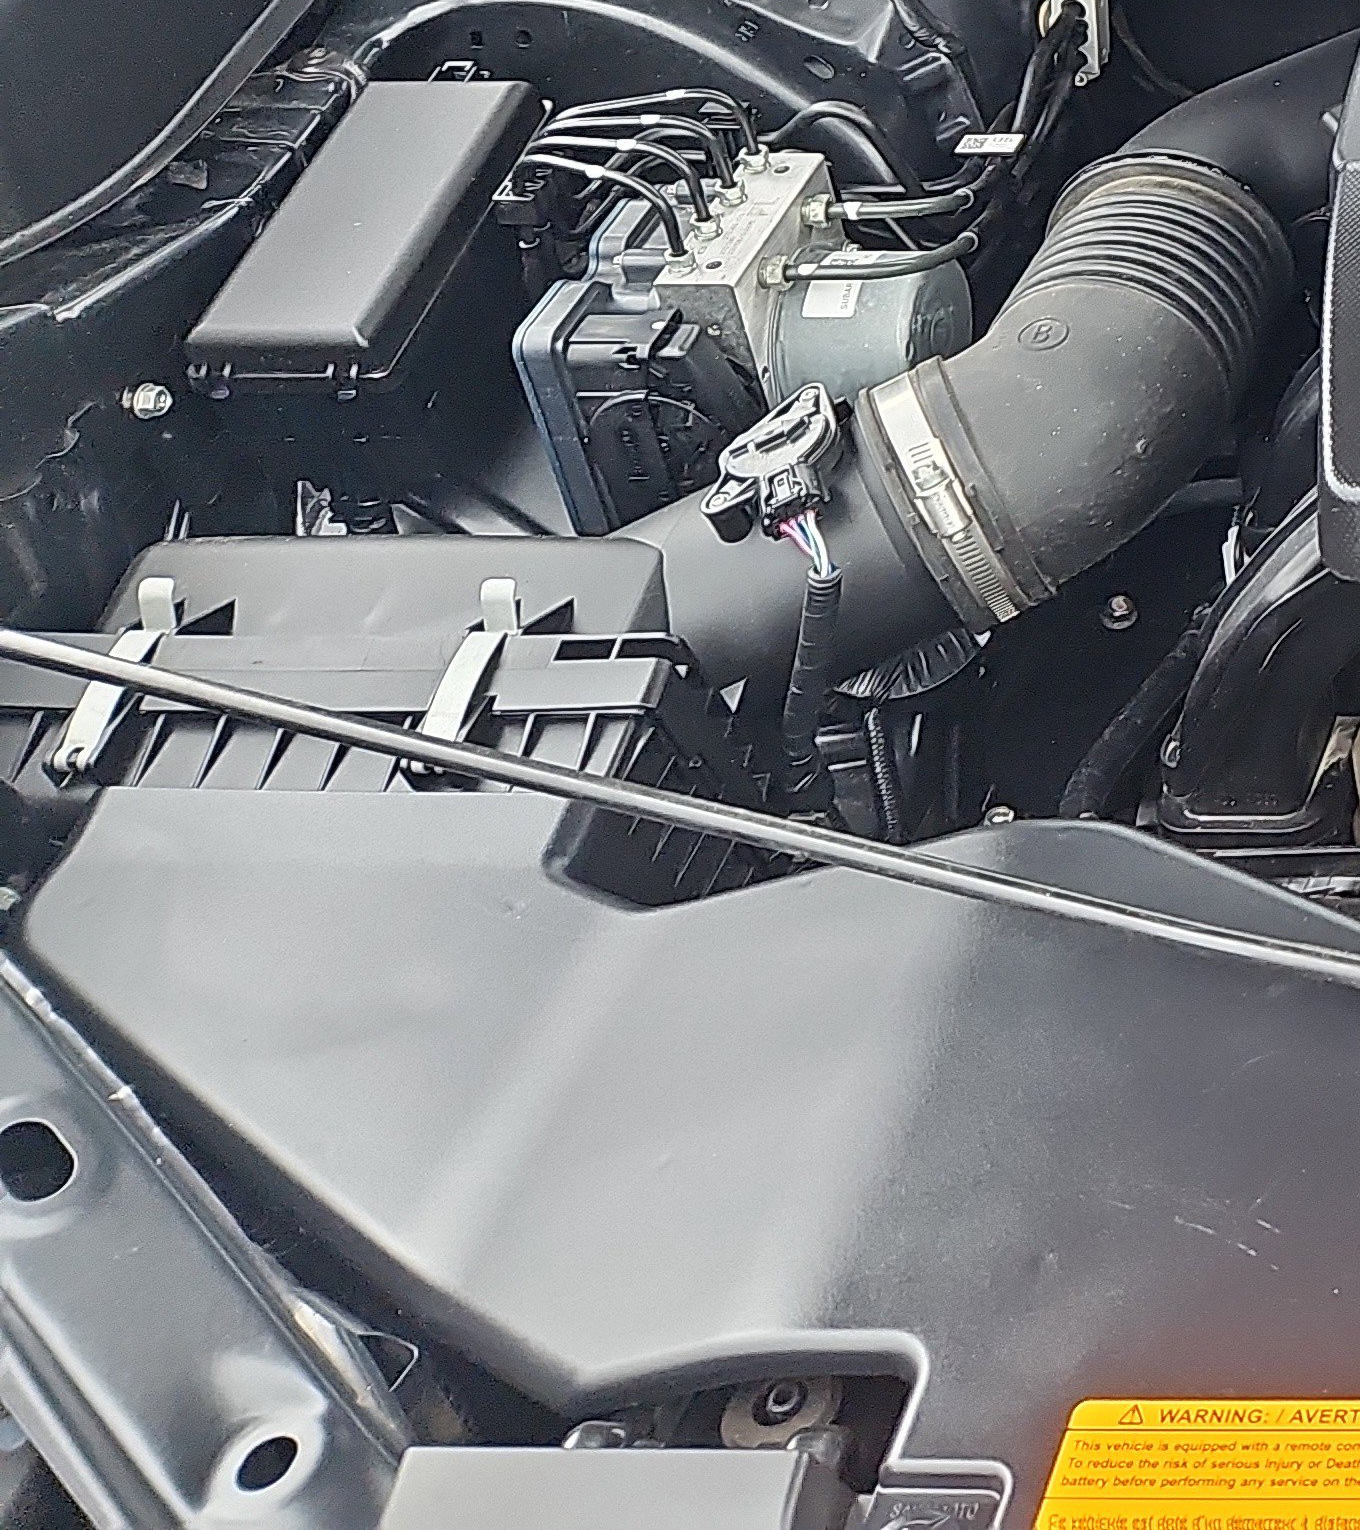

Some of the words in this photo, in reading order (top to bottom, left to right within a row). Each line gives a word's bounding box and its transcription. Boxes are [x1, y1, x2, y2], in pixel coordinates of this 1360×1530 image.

[1033, 324, 1052, 343] B
[1159, 1408, 1269, 1424] WARNING:
[1074, 1439, 1101, 1452] This
[1106, 1439, 1154, 1452] vehicle
[1157, 1440, 1169, 1452] is
[1173, 1440, 1237, 1455] equipped
[1240, 1439, 1269, 1452] with
[1272, 1443, 1281, 1452] a
[1284, 1441, 1332, 1452] remote
[1068, 1457, 1083, 1469] To
[1087, 1457, 1134, 1469] reduce
[1138, 1457, 1160, 1469] the
[1163, 1457, 1188, 1469] risk
[1193, 1457, 1209, 1469] of
[1210, 1458, 1260, 1469] serious
[1264, 1458, 1303, 1472] Injury
[1308, 1460, 1322, 1469] or
[1061, 1475, 1108, 1489] battery
[1112, 1475, 1157, 1487] before
[1160, 1475, 1236, 1490] performing
[1240, 1477, 1264, 1489] any
[1269, 1476, 1318, 1487] service
[1322, 1478, 1340, 1487] on
